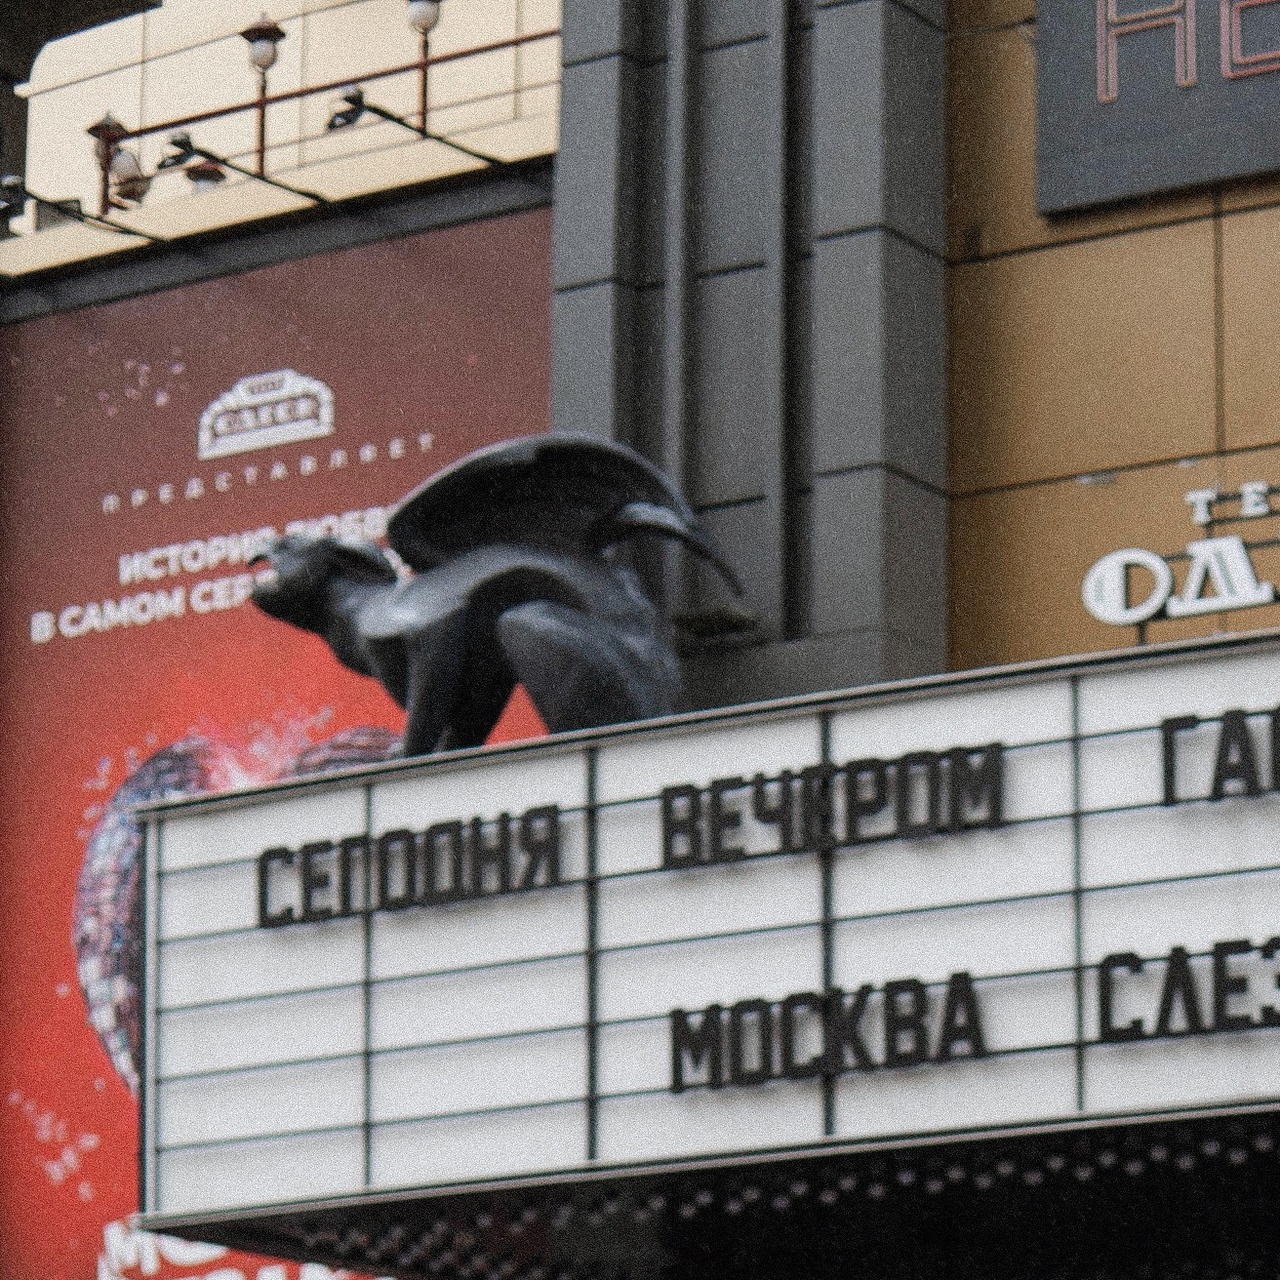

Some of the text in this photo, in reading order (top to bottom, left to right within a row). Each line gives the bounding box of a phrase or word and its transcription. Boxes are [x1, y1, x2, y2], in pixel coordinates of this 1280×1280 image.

[30, 610, 56, 644] В
[57, 586, 187, 639] САМОМ
[671, 971, 993, 1093] МОСКВА
